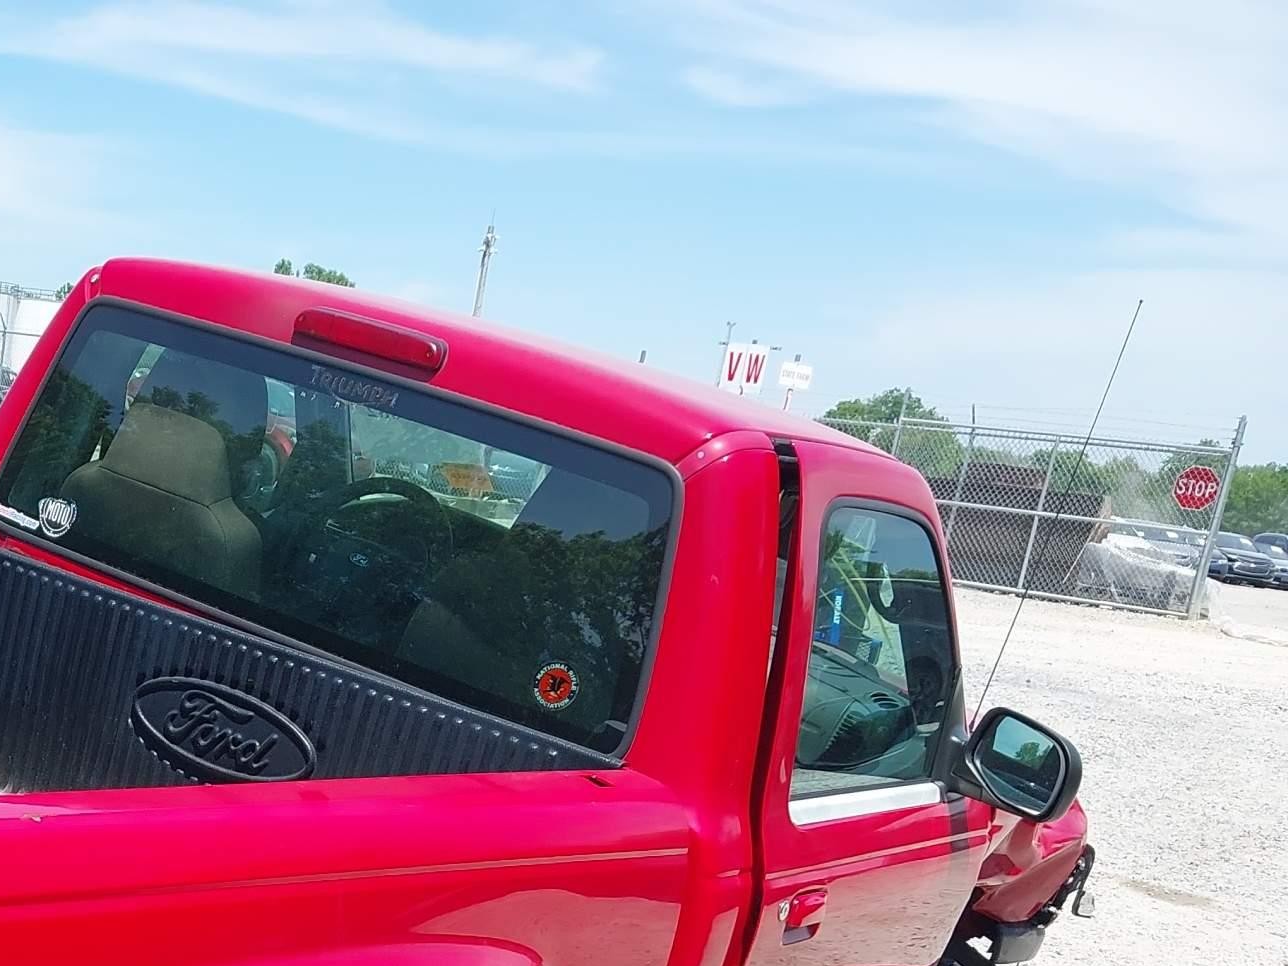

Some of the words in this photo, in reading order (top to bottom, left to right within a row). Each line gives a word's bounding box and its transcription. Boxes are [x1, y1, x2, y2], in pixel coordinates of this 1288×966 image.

[311, 364, 399, 409] TRIUMPH
[1175, 479, 1218, 498] STOP
[45, 499, 71, 526] MOTO
[535, 663, 569, 680] NATIONAL
[533, 687, 570, 709] ASSOCIATION
[164, 689, 279, 776] Ford
